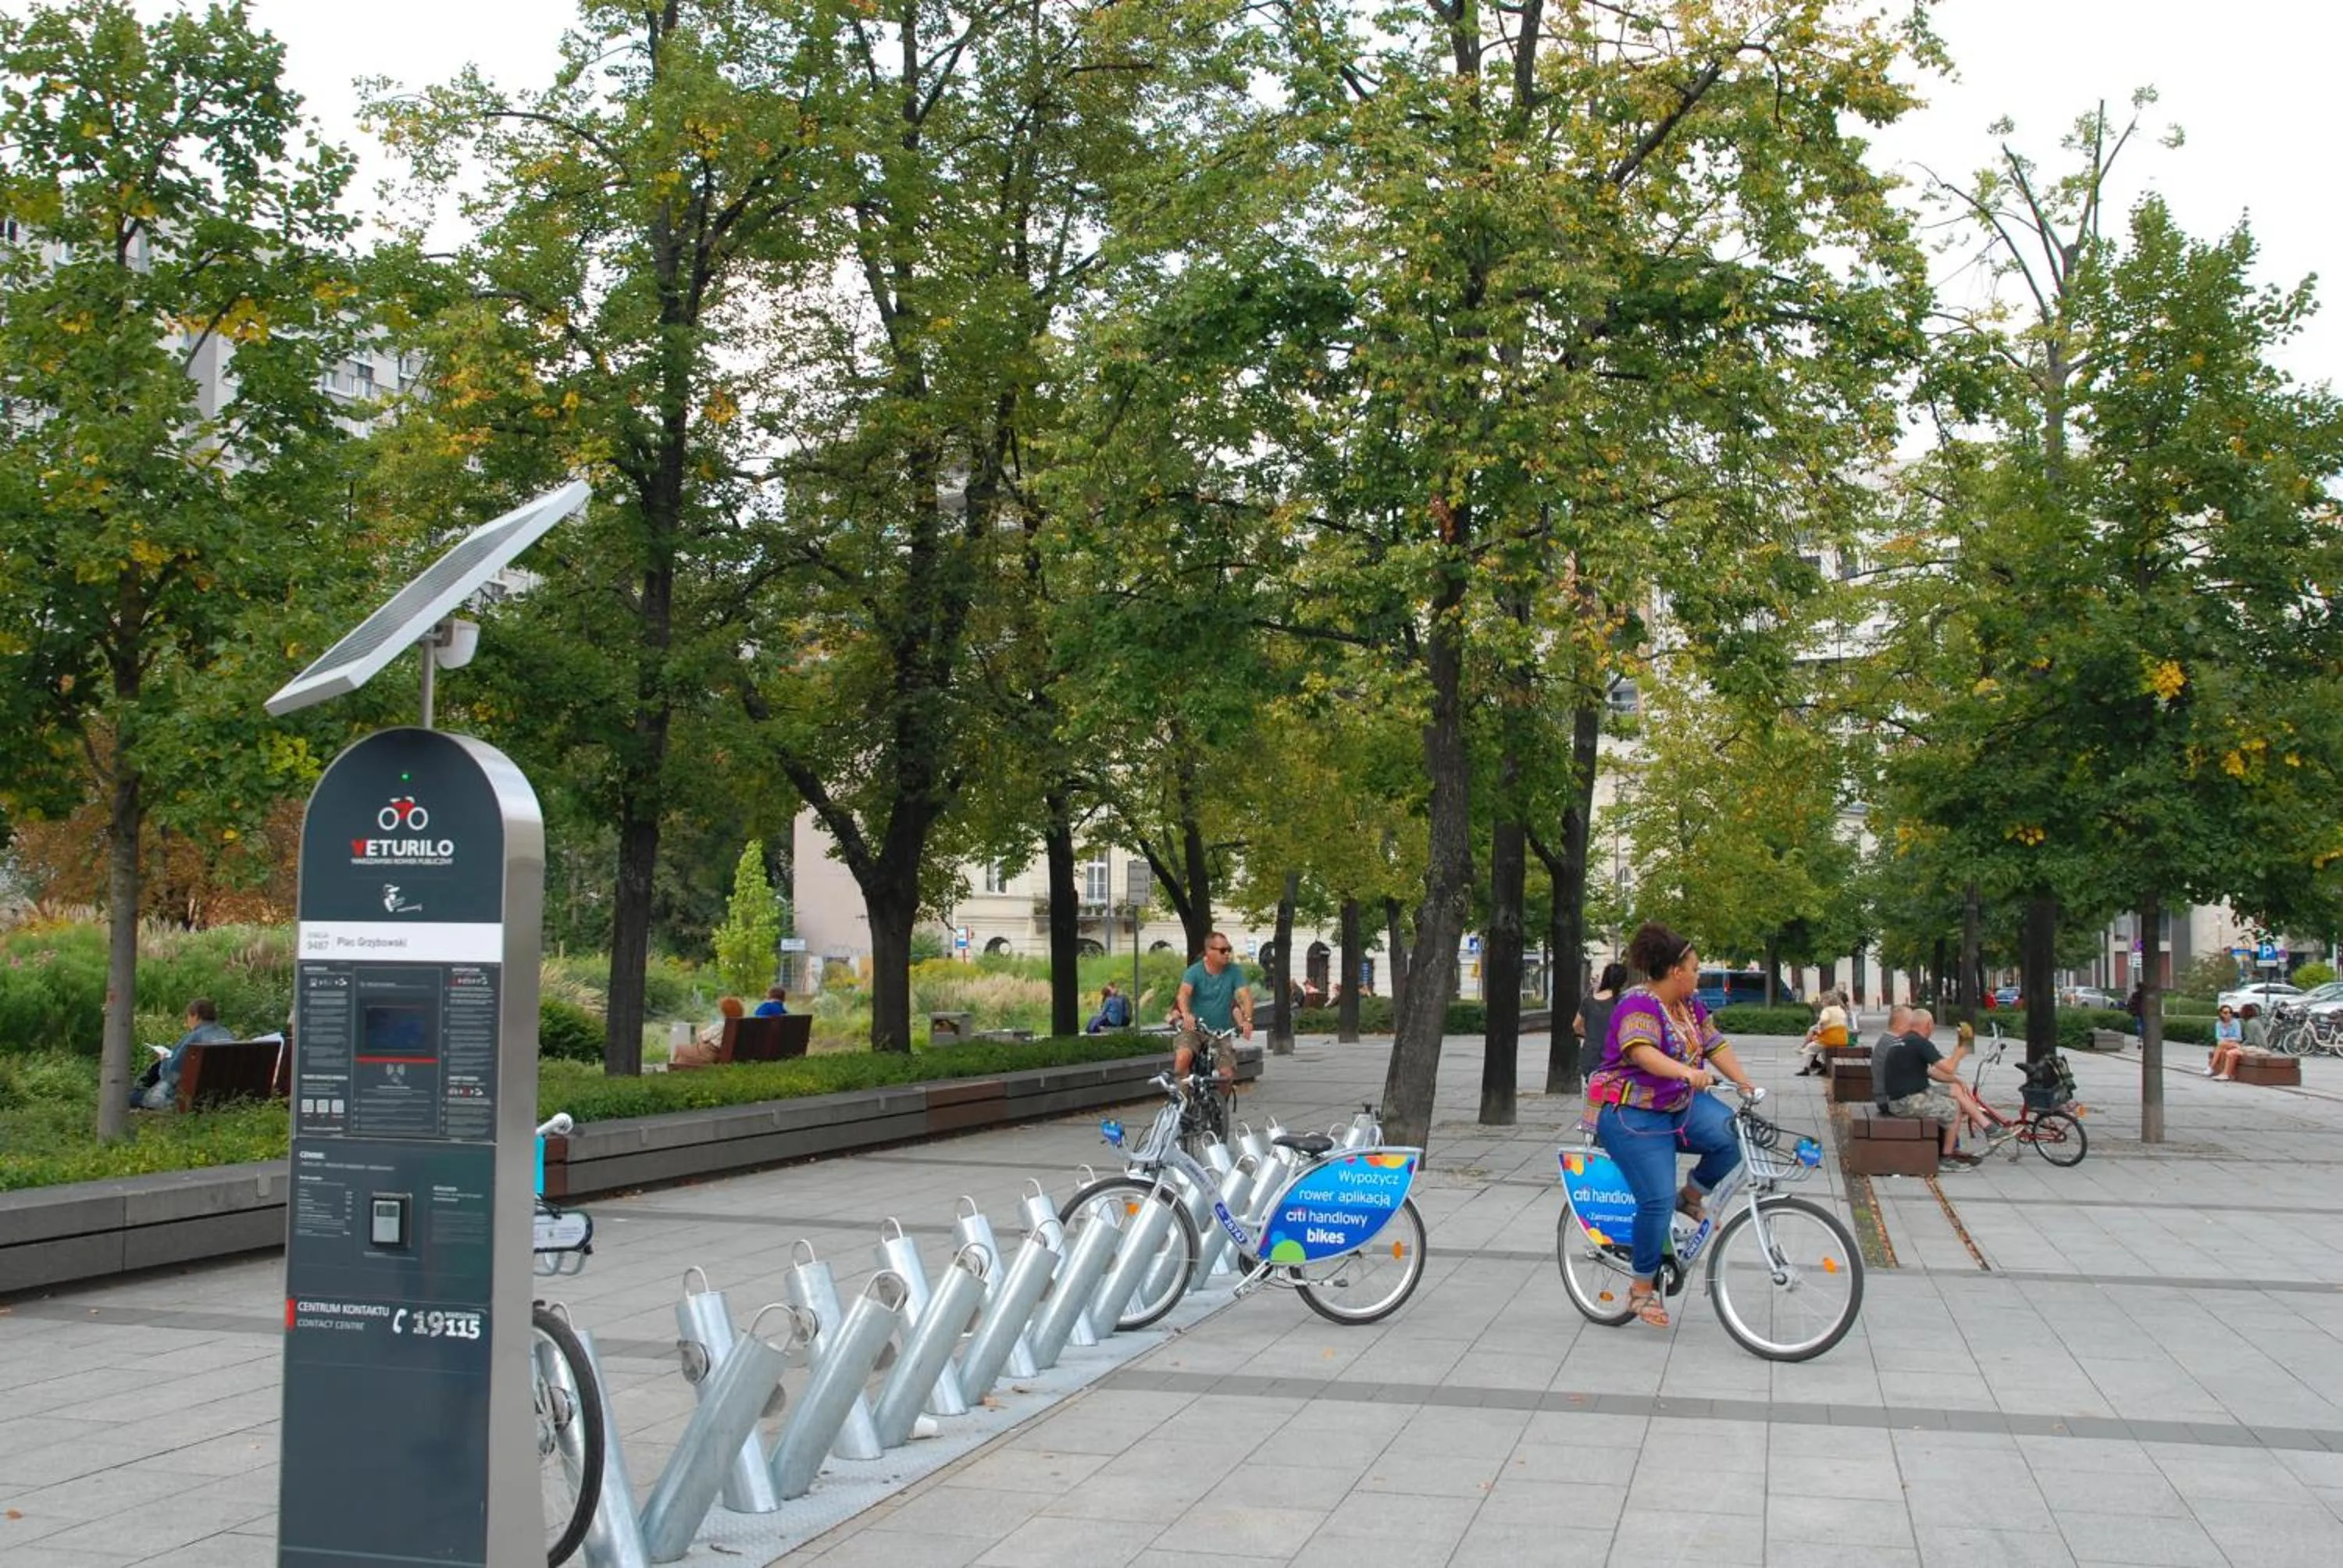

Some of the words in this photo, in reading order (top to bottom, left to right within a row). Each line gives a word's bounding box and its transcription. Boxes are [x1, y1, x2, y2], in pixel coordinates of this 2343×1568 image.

[351, 839, 454, 857] VETURILO
[1338, 1170, 1400, 1186] Wypożycz
[1299, 1189, 1334, 1201] rower
[1338, 1190, 1391, 1207] aplikacją
[1574, 1188, 1591, 1202] citi
[1592, 1188, 1636, 1205] handlow
[1286, 1209, 1307, 1222] citi
[1308, 1210, 1368, 1228] handlowy
[1307, 1228, 1345, 1244] bikes
[298, 1302, 341, 1313] CENTRUM
[342, 1304, 390, 1317] KONTAKTU
[298, 1319, 333, 1328] CONTACT
[335, 1320, 365, 1331] CENTRE
